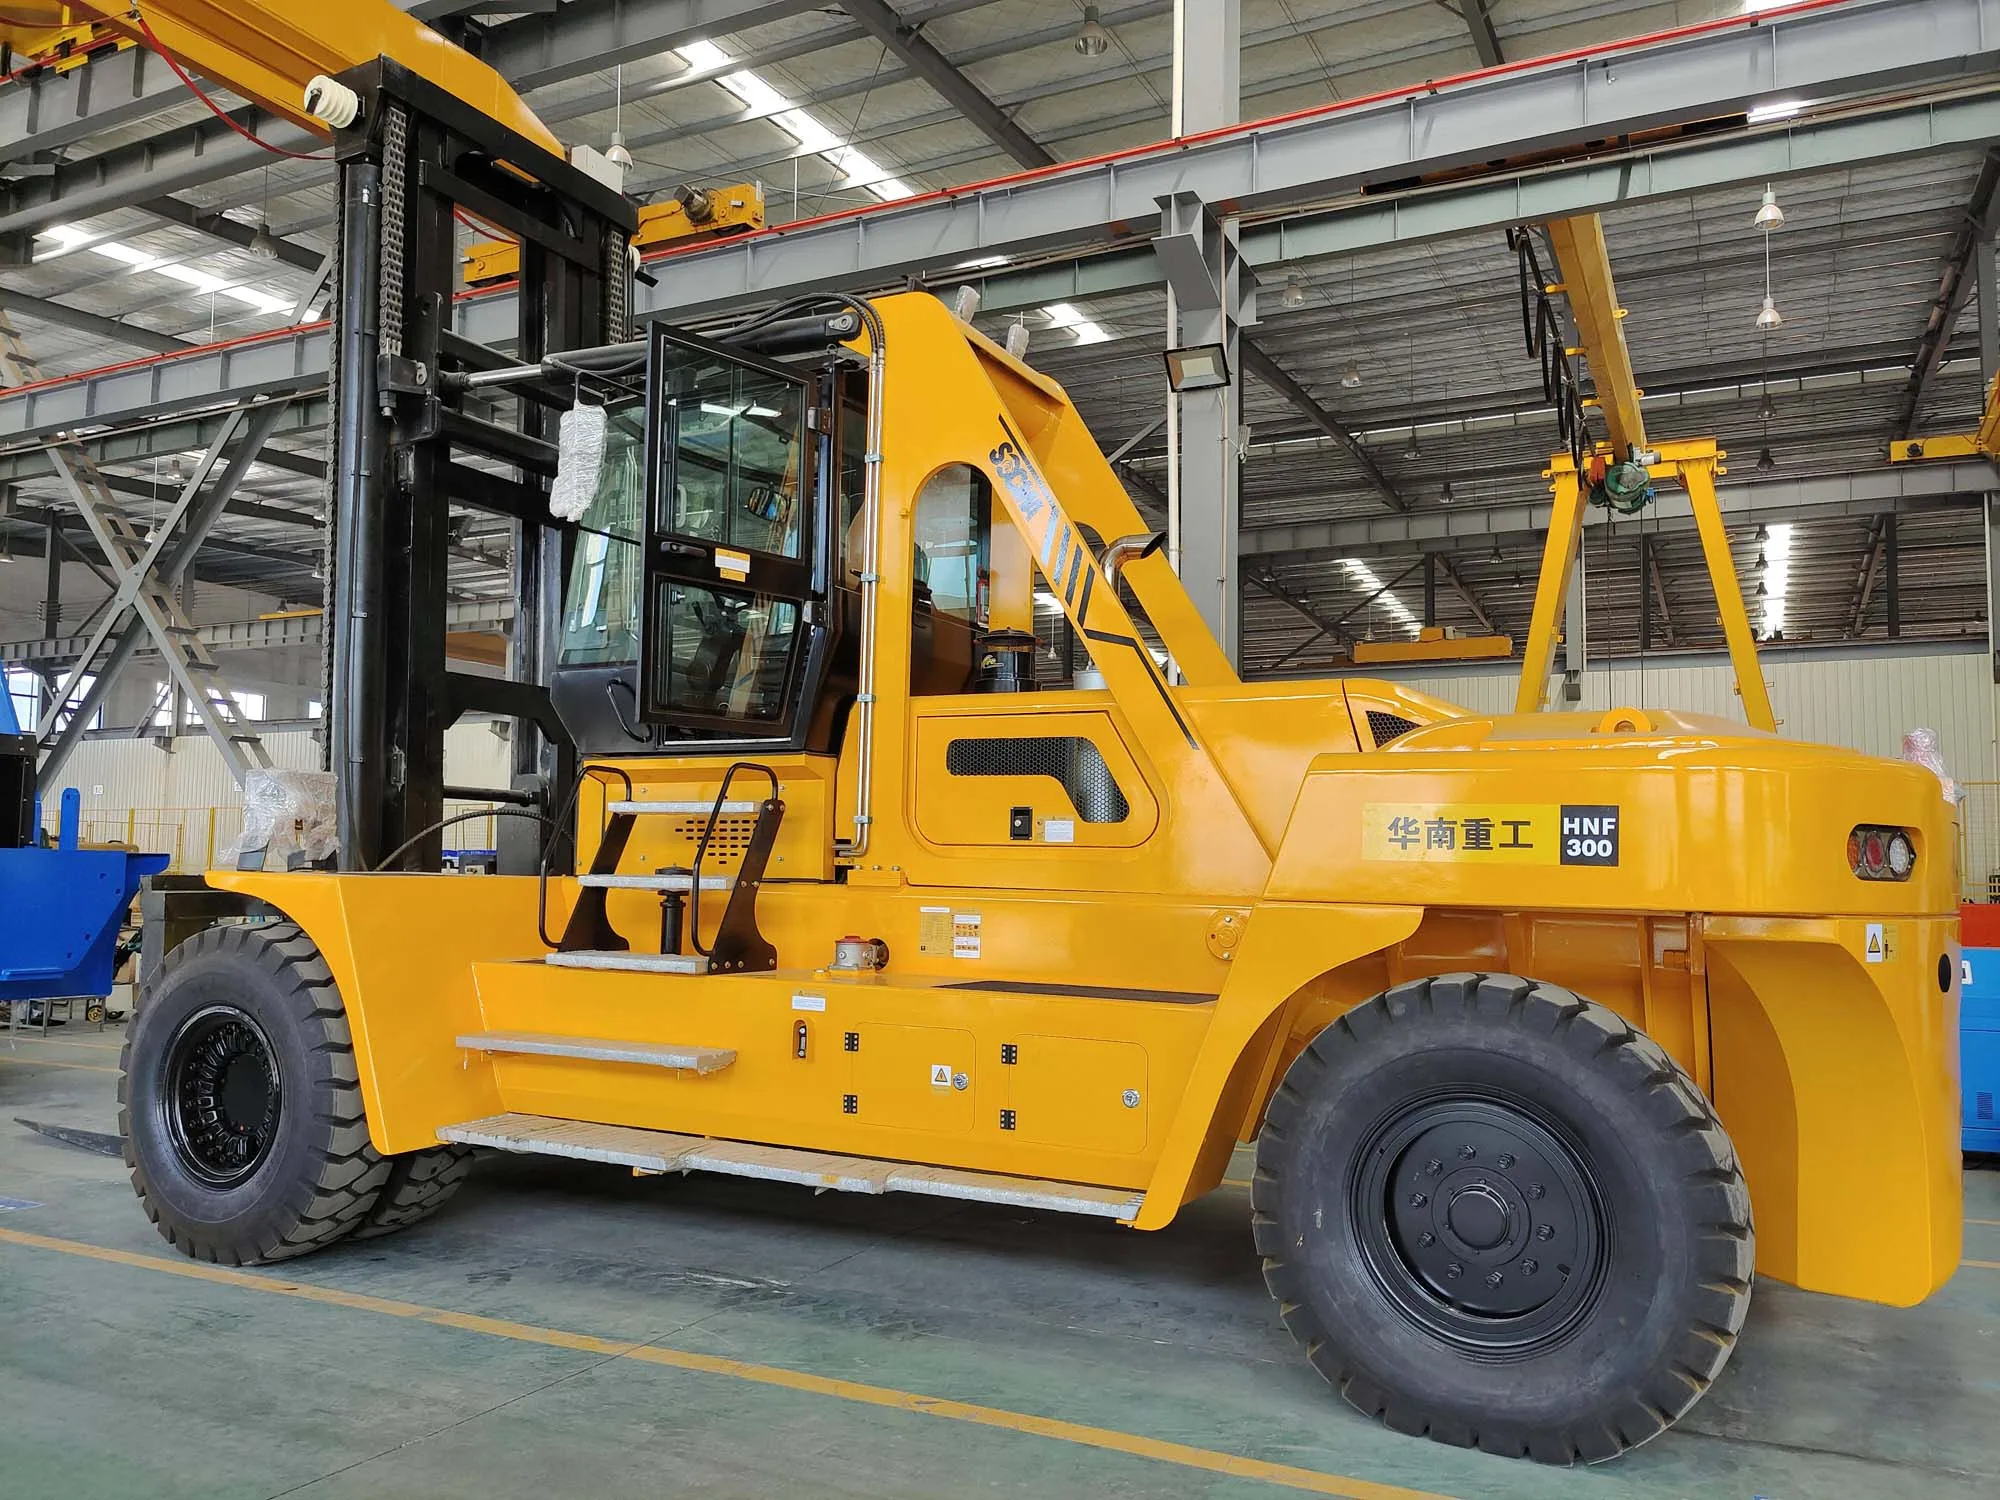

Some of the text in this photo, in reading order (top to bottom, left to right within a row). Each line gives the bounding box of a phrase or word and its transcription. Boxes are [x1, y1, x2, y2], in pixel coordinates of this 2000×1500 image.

[1388, 816, 1534, 850] 华南重工
[1562, 817, 1616, 836] HNF
[1566, 838, 1613, 857] 300
